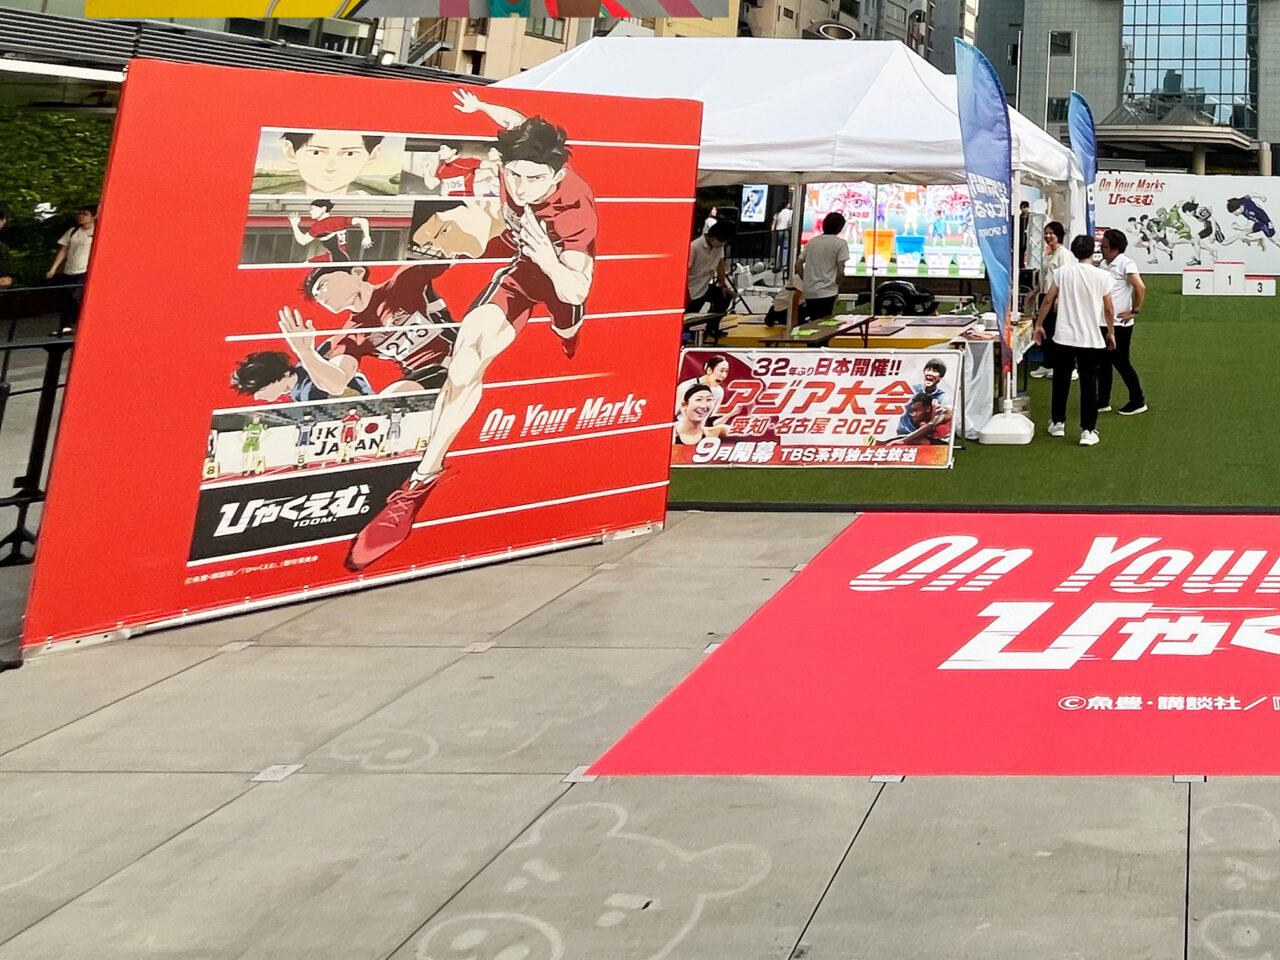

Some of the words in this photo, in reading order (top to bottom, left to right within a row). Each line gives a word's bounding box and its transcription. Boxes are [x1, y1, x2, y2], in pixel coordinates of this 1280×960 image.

[1099, 178, 1111, 192] On
[1114, 178, 1135, 192] Your
[1136, 179, 1166, 192] Marks
[1195, 278, 1201, 289] 2
[1228, 275, 1232, 285] 1
[1257, 282, 1263, 293] 3
[386, 322, 429, 355] 273
[719, 380, 914, 416] アジア大会
[479, 408, 516, 442] On
[520, 403, 576, 437] Your
[575, 393, 647, 430] Marks
[831, 418, 889, 435] 2026
[314, 433, 385, 456] JAAN
[692, 437, 778, 463] 9月開幕
[780, 447, 918, 463] TBS系列独占生放送
[206, 465, 215, 475] 8
[849, 535, 1033, 592] On
